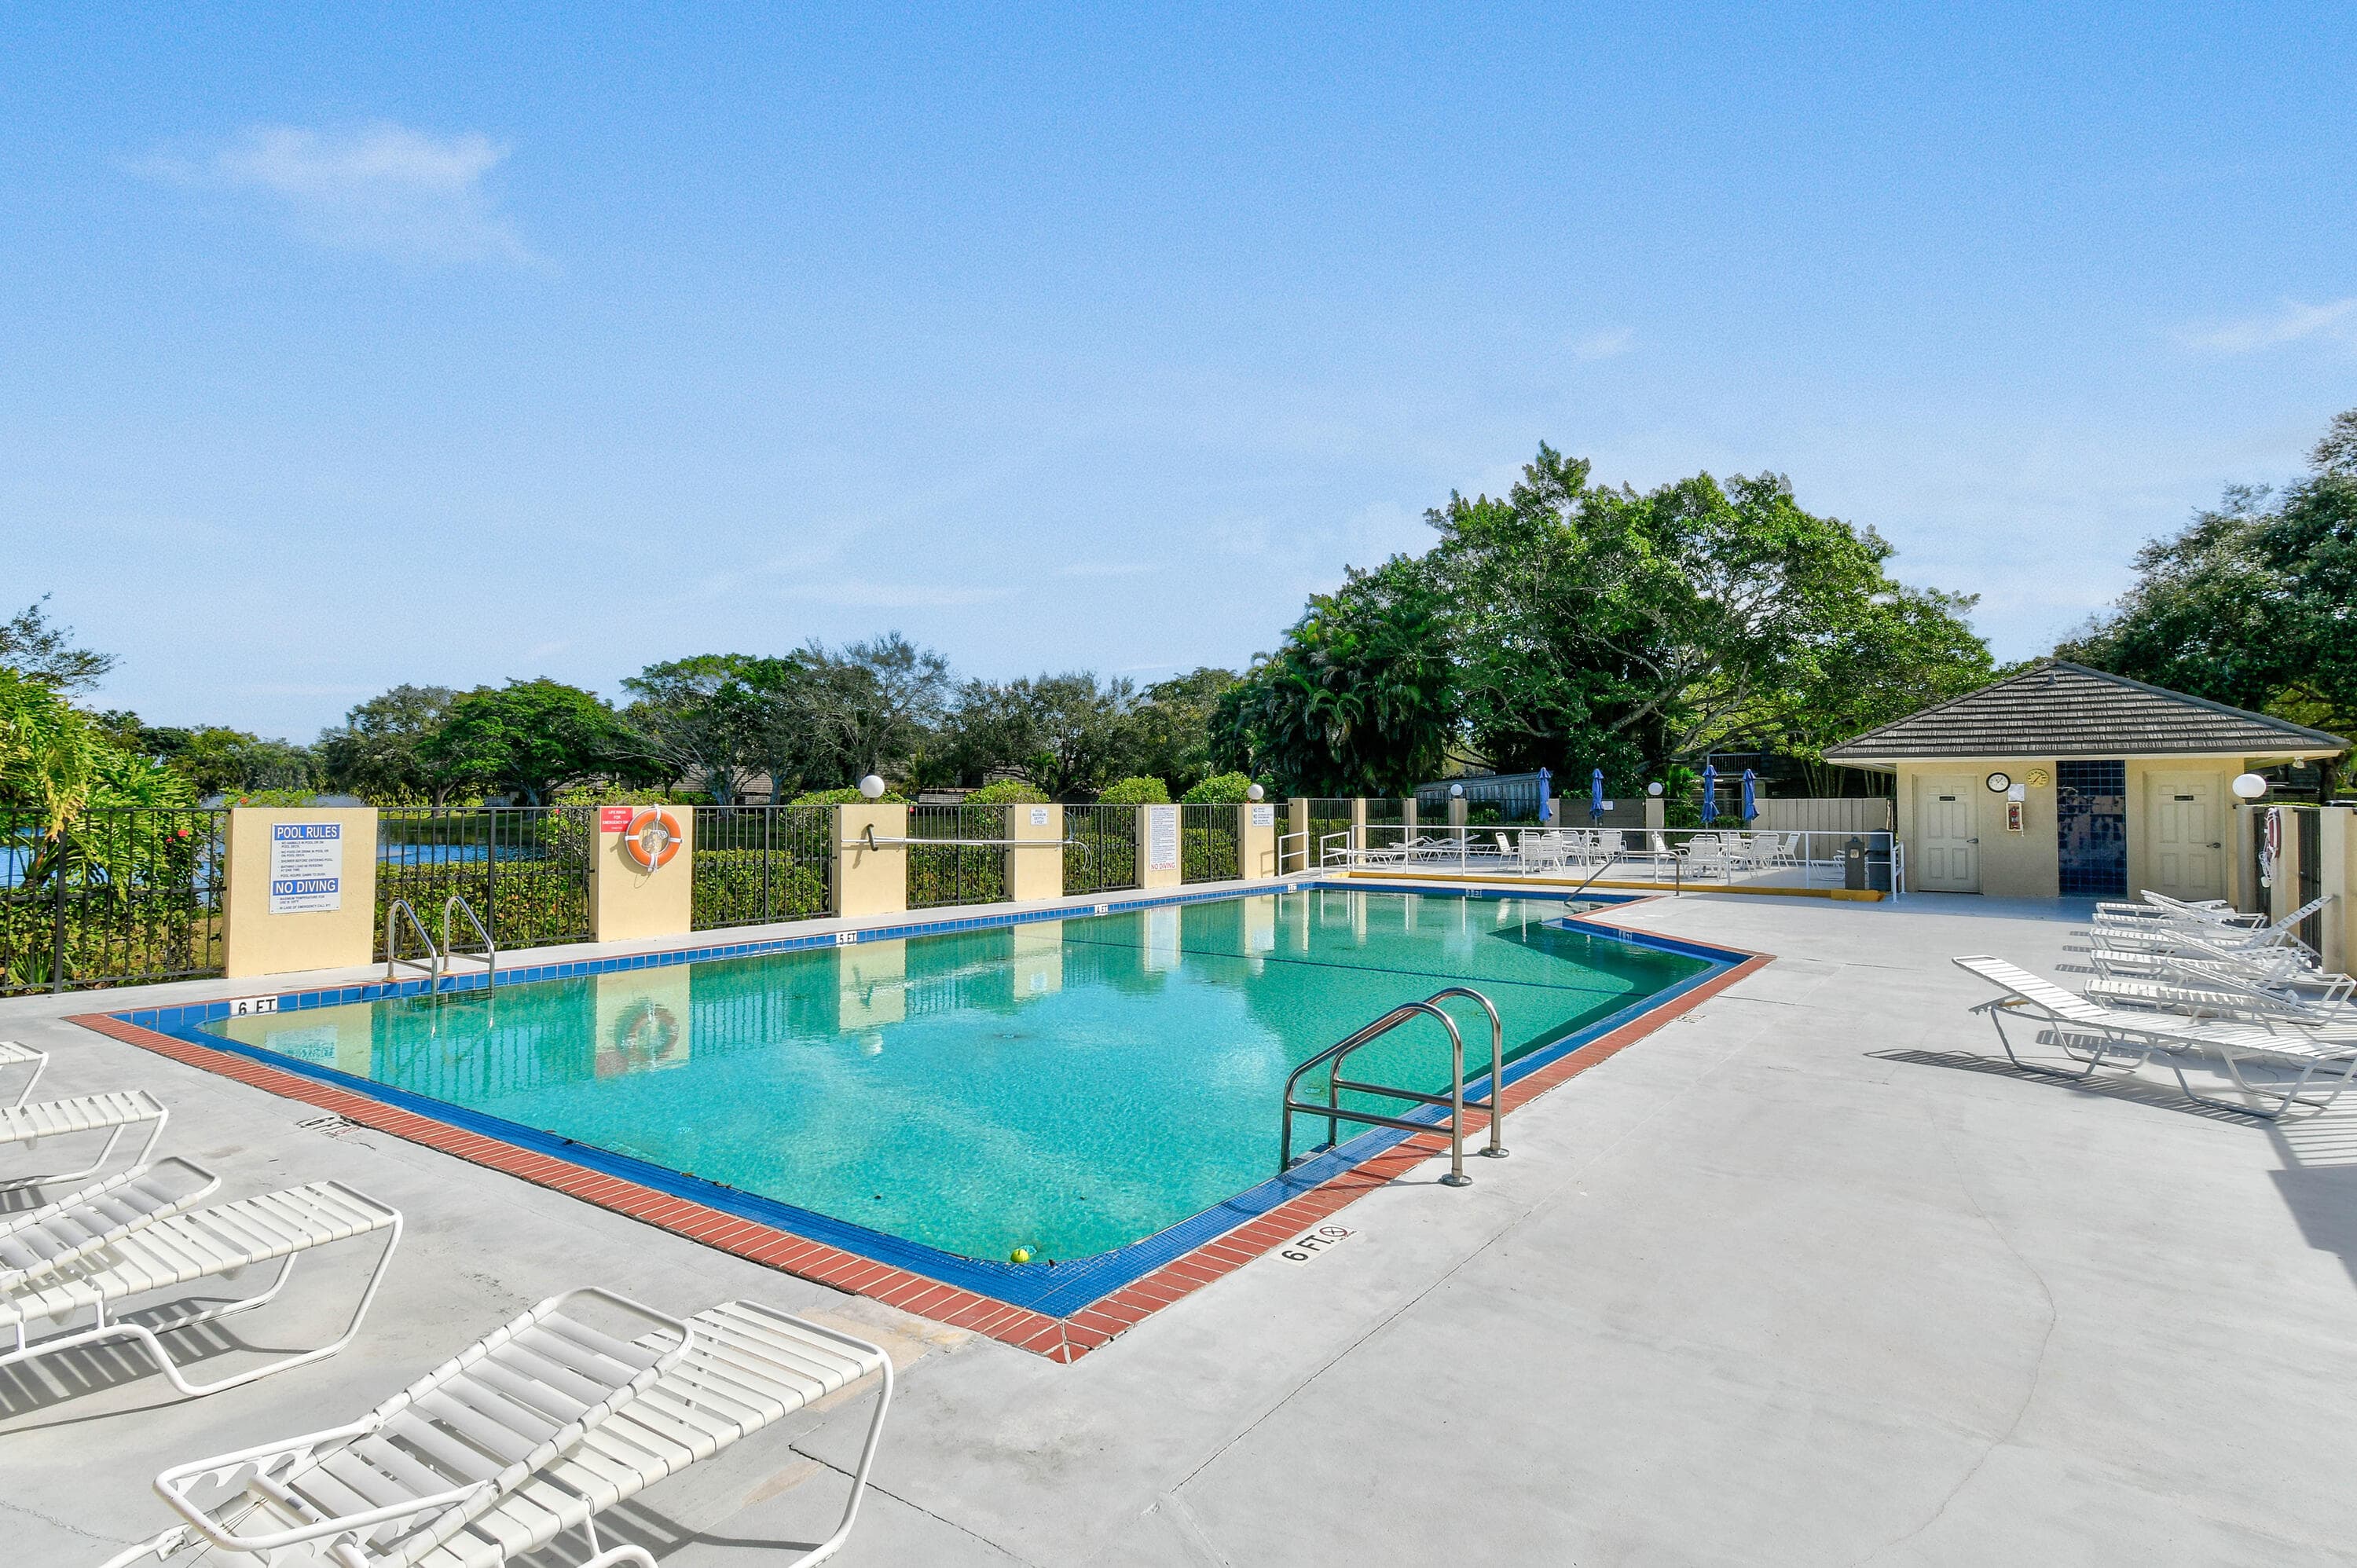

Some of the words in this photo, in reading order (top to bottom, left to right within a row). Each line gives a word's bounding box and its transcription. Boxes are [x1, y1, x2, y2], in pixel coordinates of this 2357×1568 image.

[277, 826, 304, 838] POOL
[306, 826, 337, 837] RULES
[276, 881, 293, 894] NO
[296, 879, 336, 893] DIVING
[847, 932, 856, 943] FT
[238, 1002, 247, 1015] 6
[256, 998, 277, 1013] FT
[304, 1116, 335, 1127] 6
[1281, 1250, 1309, 1262] 6
